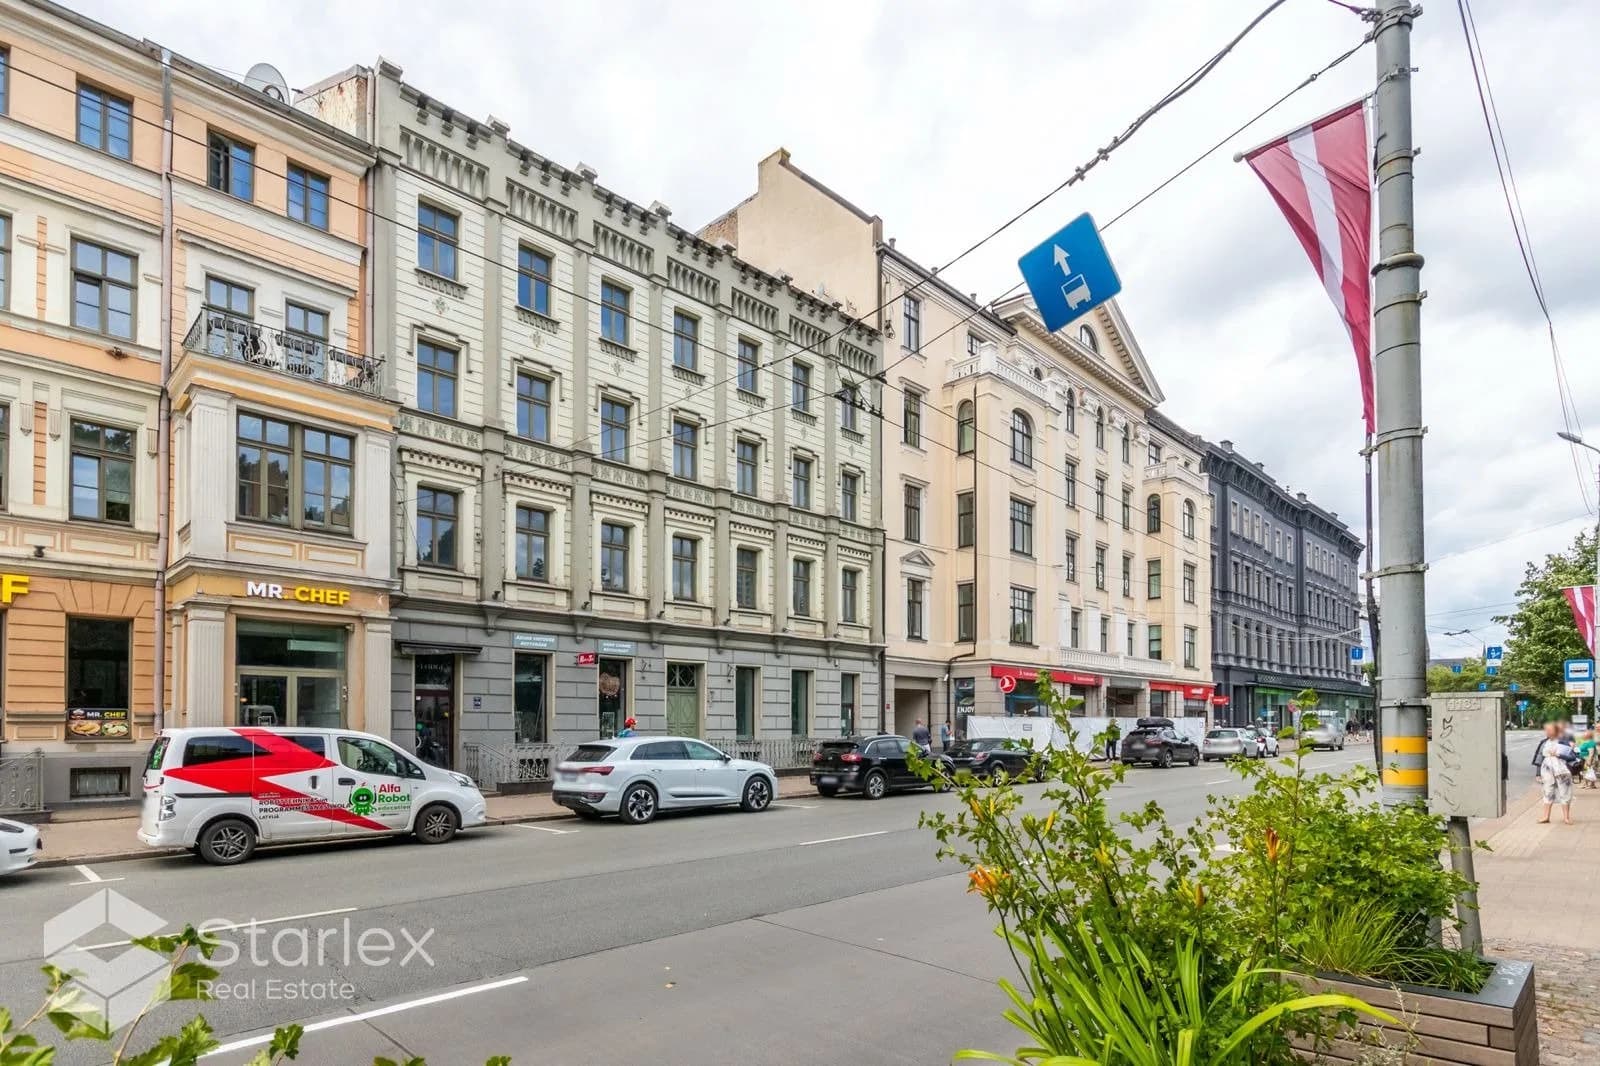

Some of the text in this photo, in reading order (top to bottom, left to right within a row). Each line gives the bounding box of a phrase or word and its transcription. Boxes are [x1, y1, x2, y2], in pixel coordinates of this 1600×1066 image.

[247, 581, 350, 605] MR. CHEF
[379, 783, 401, 793] Alfa
[378, 793, 411, 803] Robot
